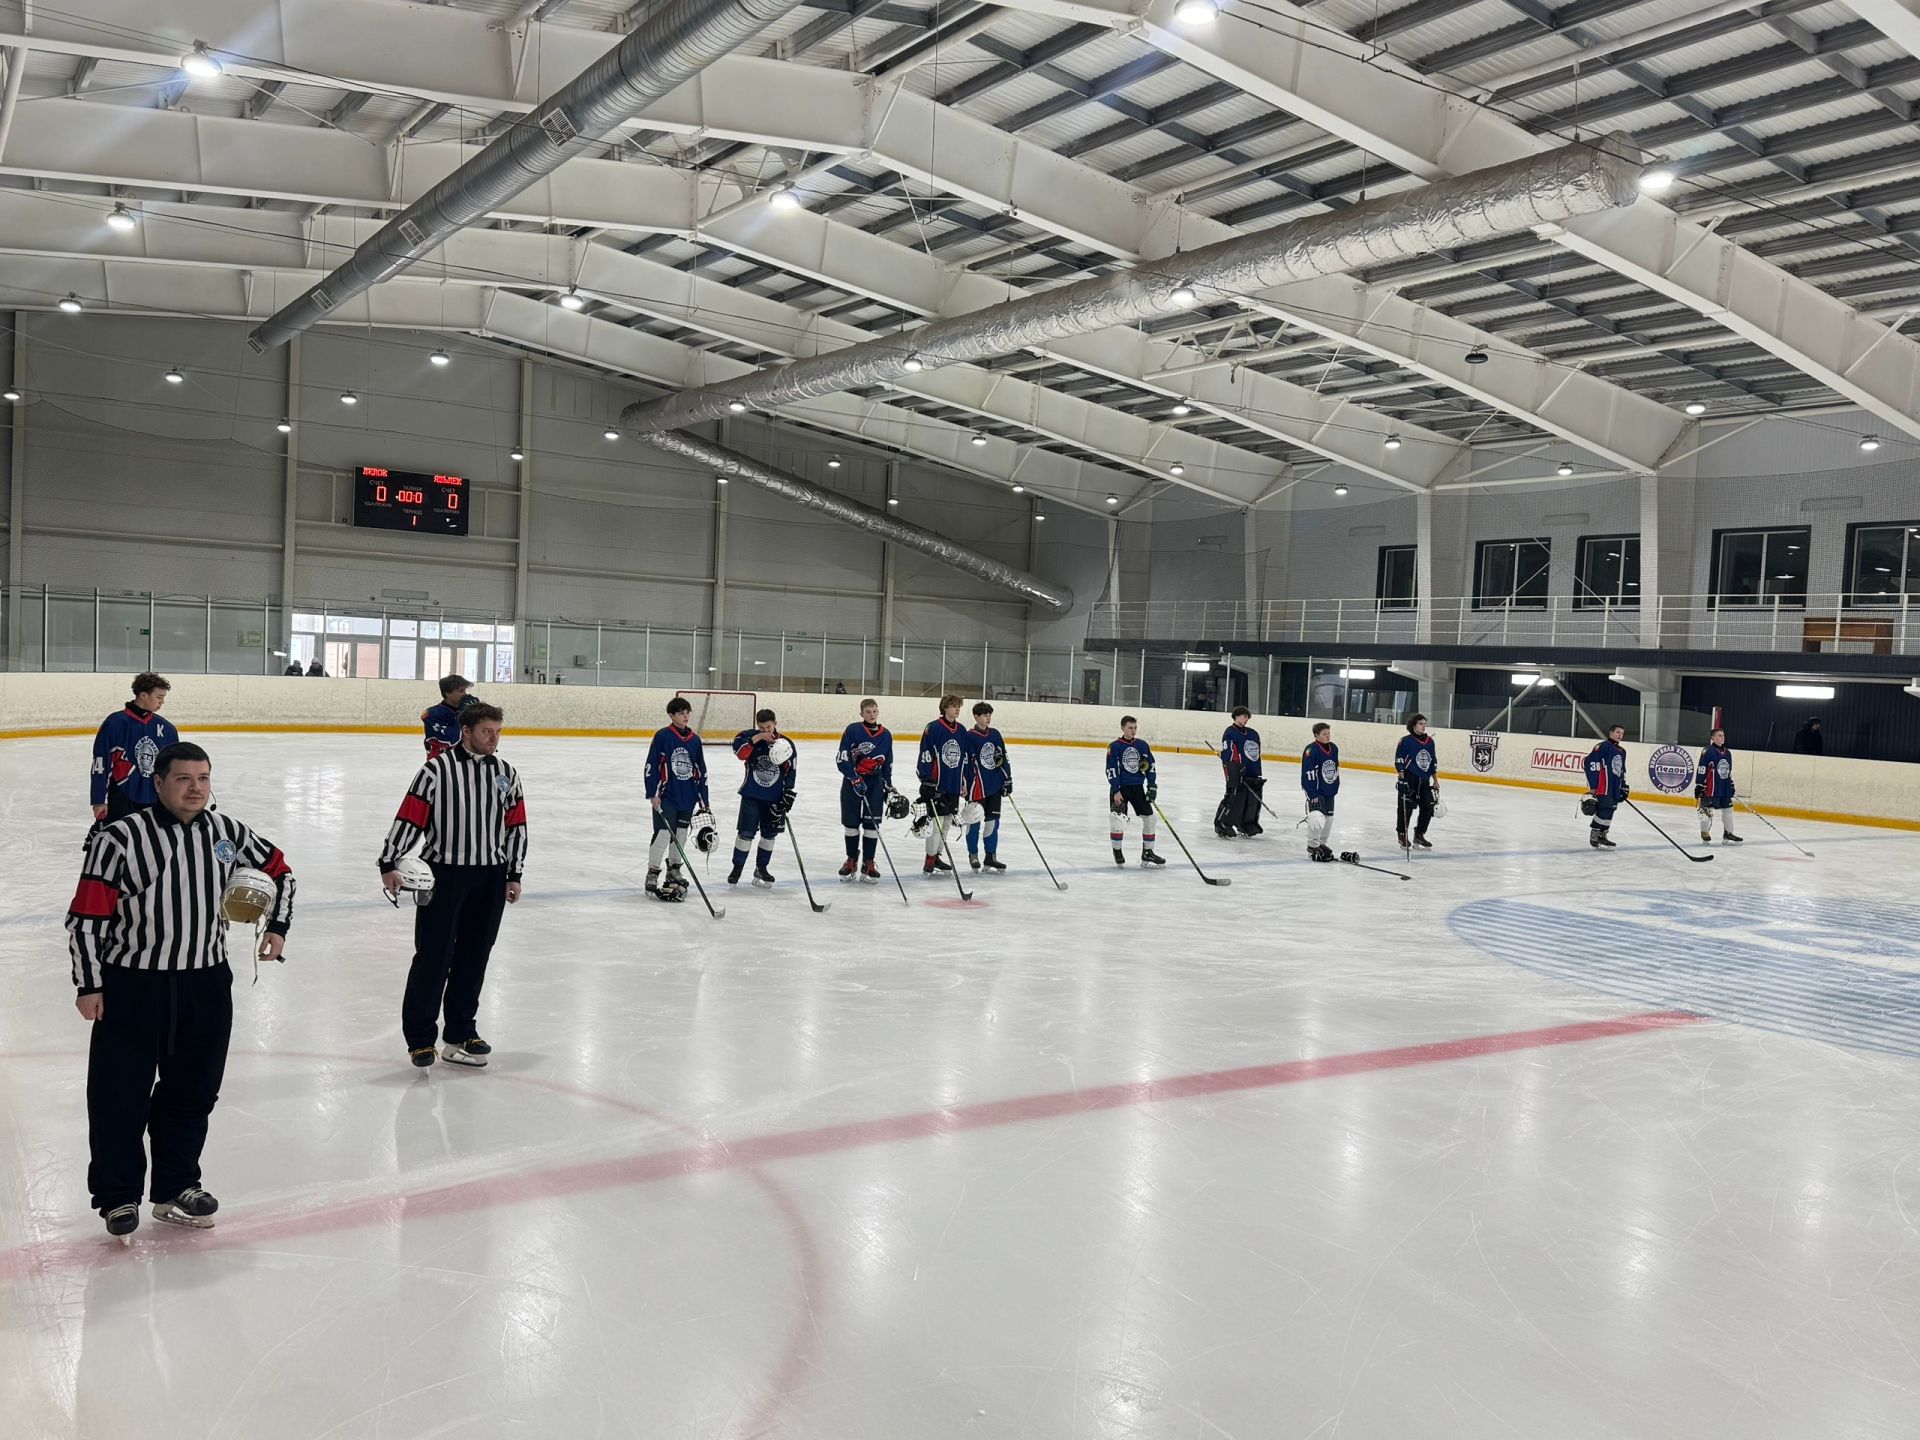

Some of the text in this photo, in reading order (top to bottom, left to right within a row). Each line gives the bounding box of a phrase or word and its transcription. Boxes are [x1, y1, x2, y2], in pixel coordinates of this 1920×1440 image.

[376, 486, 387, 502] 0
[448, 493, 458, 509] 0
[1676, 747, 1693, 773] КОМАНДА
[1106, 767, 1117, 780] 27
[1306, 769, 1316, 781] 11
